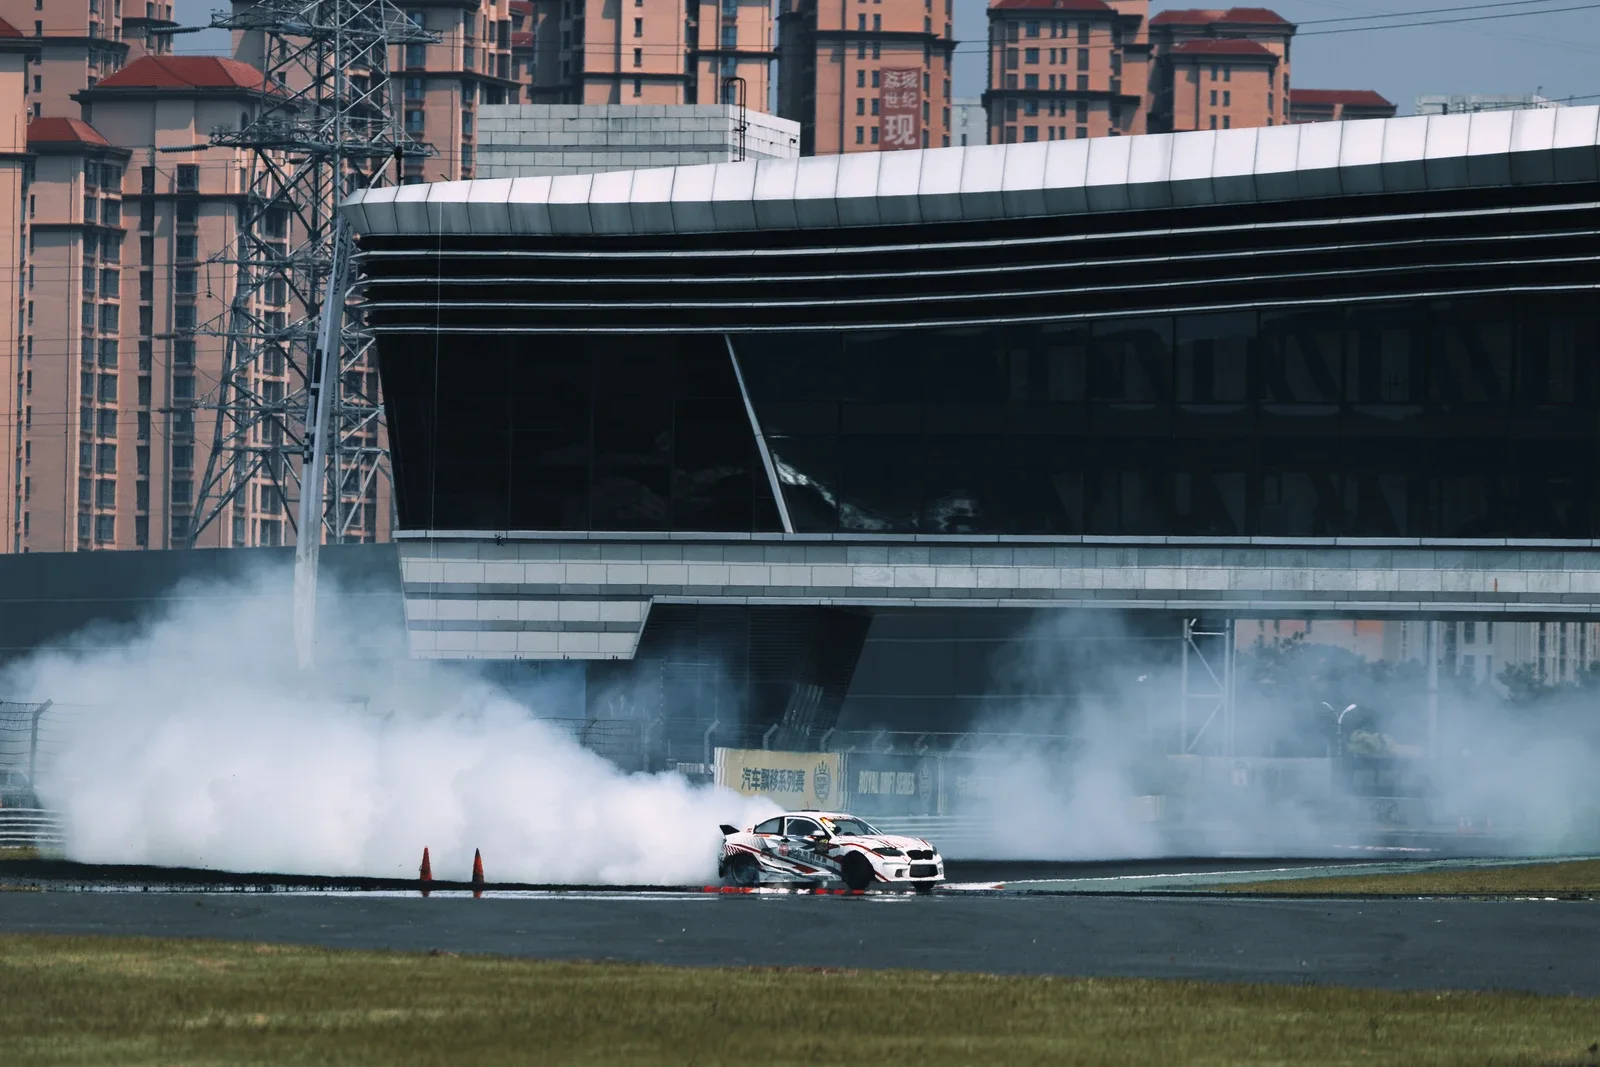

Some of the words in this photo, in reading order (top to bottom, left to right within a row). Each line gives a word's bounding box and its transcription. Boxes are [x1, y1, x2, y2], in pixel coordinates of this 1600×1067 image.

[884, 91, 918, 108] 世纪
[884, 114, 916, 145] 现
[741, 767, 805, 793] 汽车飘移系列赛
[859, 770, 879, 794] ROYAL
[896, 772, 915, 795] SERIES
